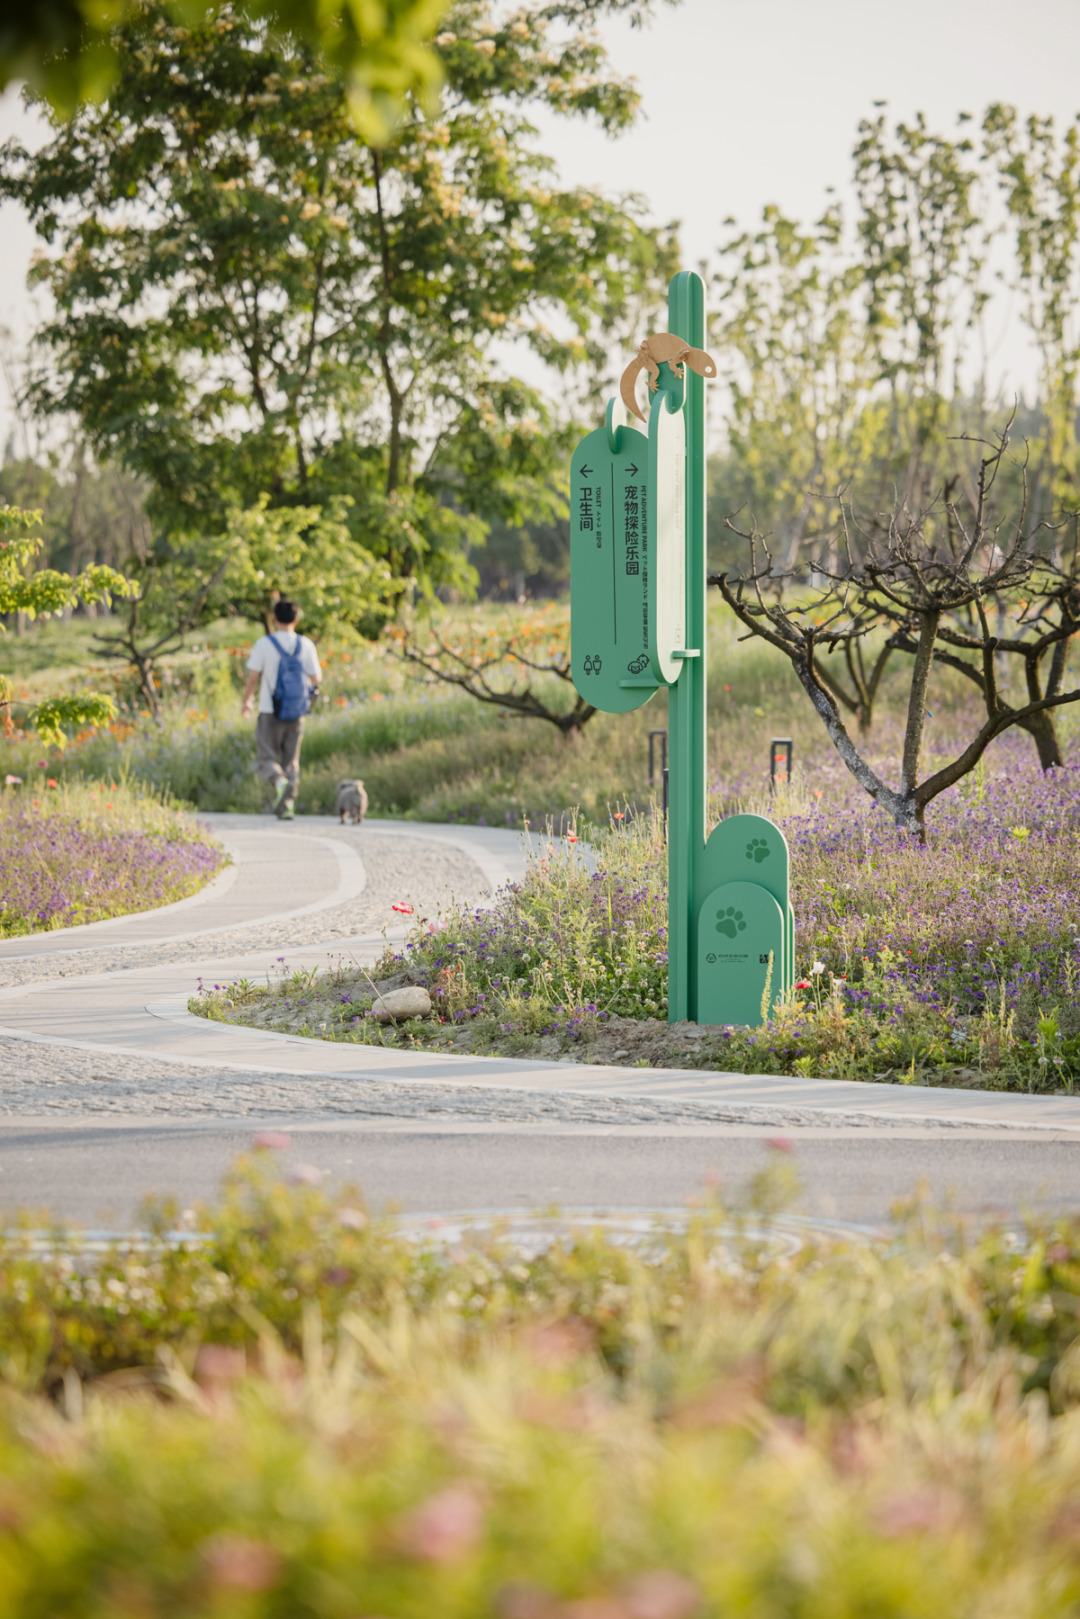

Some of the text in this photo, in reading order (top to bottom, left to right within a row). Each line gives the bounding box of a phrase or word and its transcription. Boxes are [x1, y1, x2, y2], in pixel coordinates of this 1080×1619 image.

[579, 487, 594, 531] 卫生间
[624, 485, 639, 575] 宠物探险乐园
